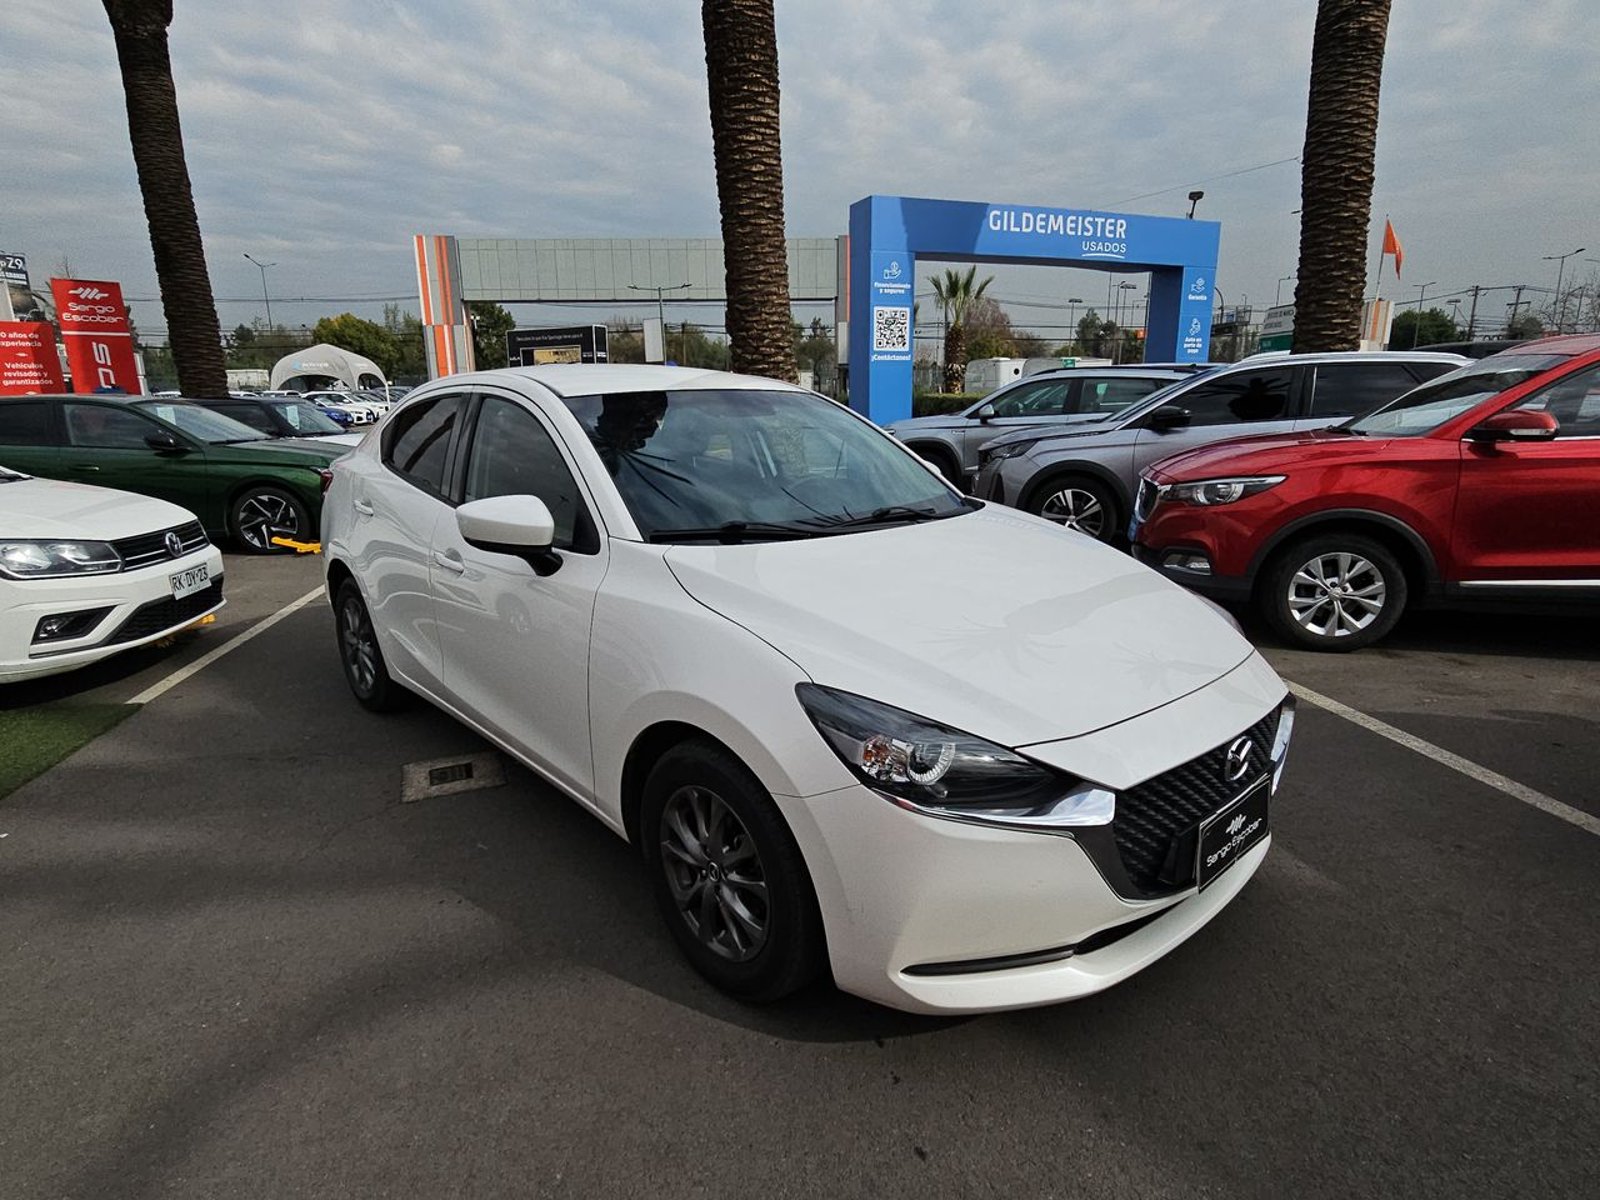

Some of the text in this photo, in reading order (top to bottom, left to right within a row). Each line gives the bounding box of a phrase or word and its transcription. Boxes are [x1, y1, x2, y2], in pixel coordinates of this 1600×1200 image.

[989, 210, 1127, 239] GILDEMEISTER
[1082, 241, 1127, 253] USADOS
[67, 302, 116, 314] Sergo
[62, 312, 124, 323] Escobar
[1206, 818, 1262, 867] Sergo Escobar
